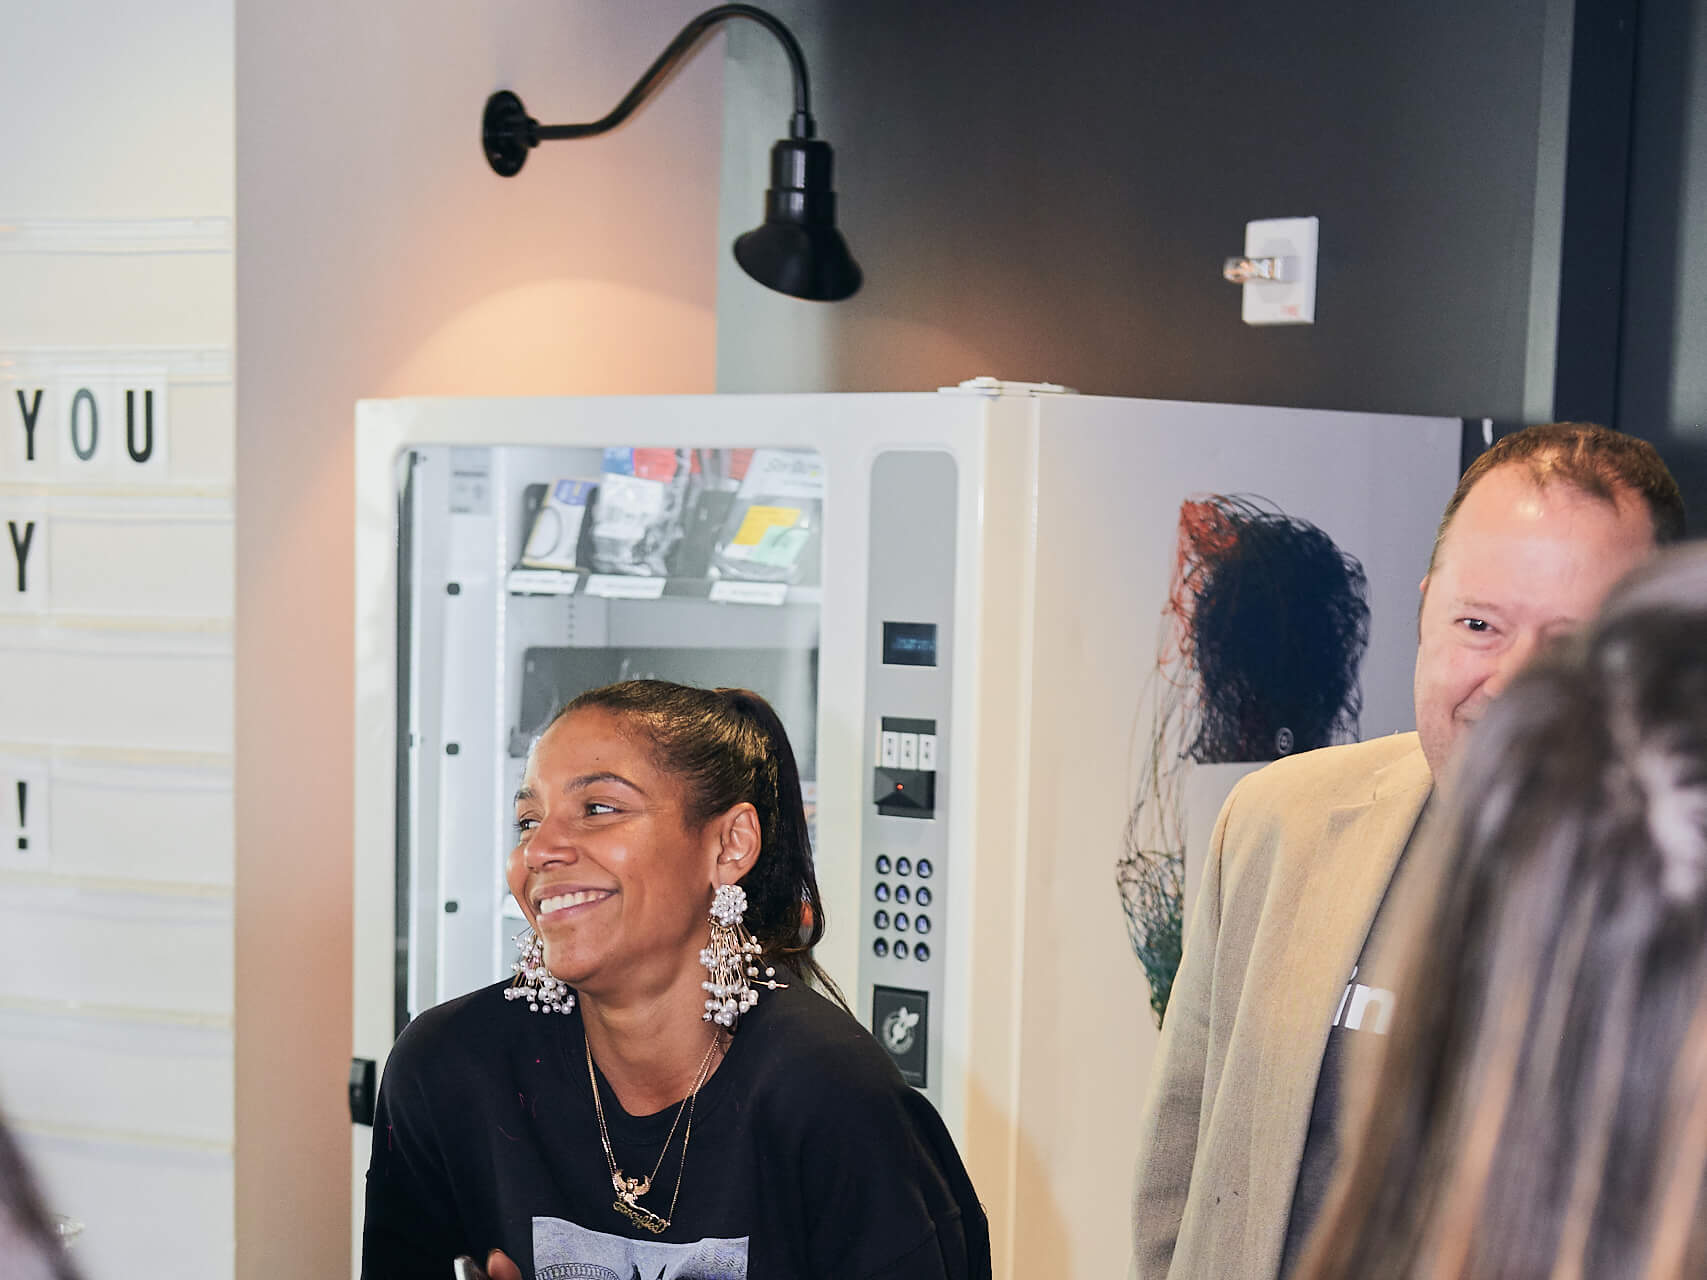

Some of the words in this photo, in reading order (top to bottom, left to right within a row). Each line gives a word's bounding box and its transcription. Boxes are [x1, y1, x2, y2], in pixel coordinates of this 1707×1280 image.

[16, 388, 154, 464] YOU
[7, 520, 36, 593] Y
[16, 780, 29, 851] !
